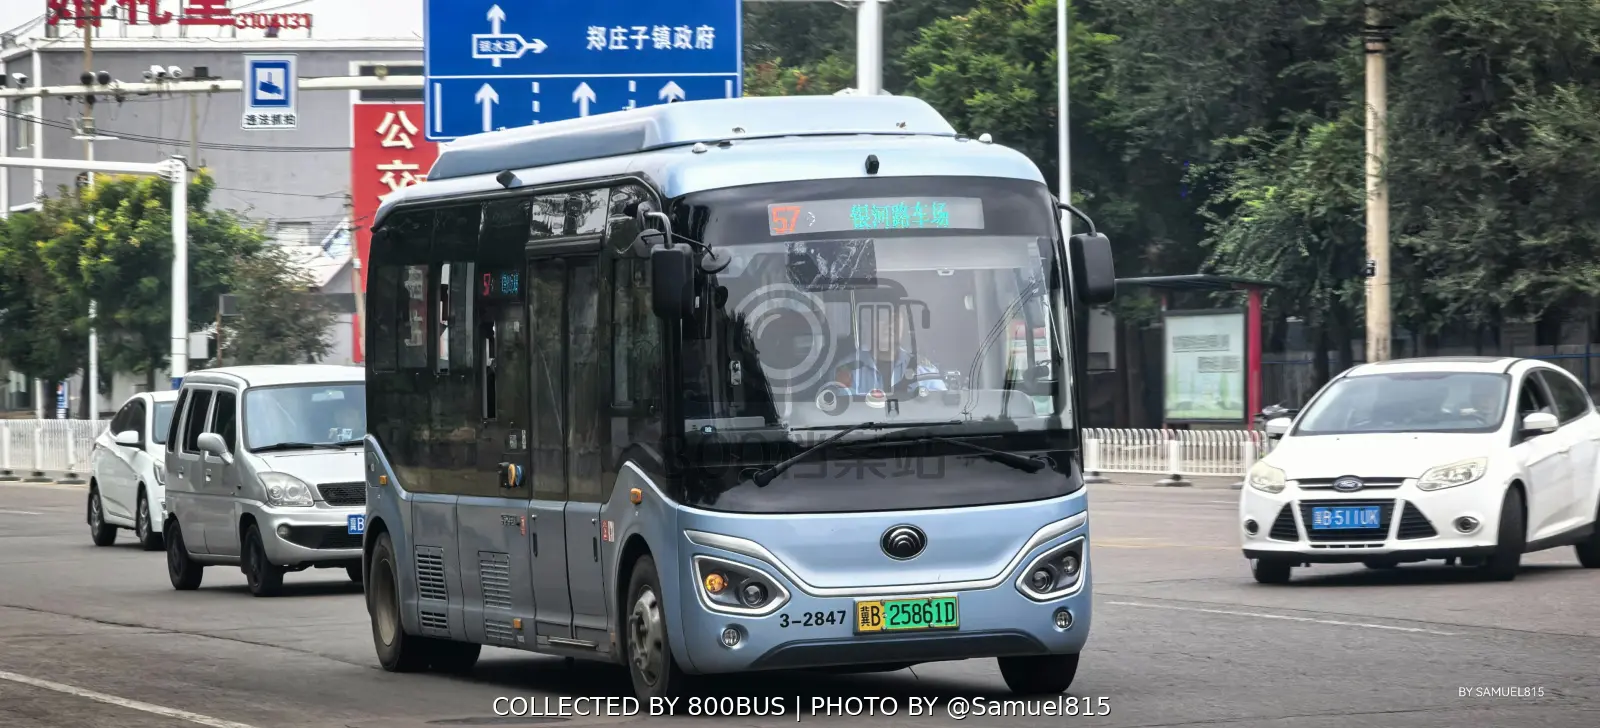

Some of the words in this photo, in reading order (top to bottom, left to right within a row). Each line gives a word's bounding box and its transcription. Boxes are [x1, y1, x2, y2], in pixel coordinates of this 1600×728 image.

[586, 24, 716, 51] 郑庄子镇政府
[244, 113, 297, 126] 违法抓拍
[772, 206, 801, 235] 57
[850, 201, 950, 230] 银河路车场
[779, 610, 847, 628] 3-2847
